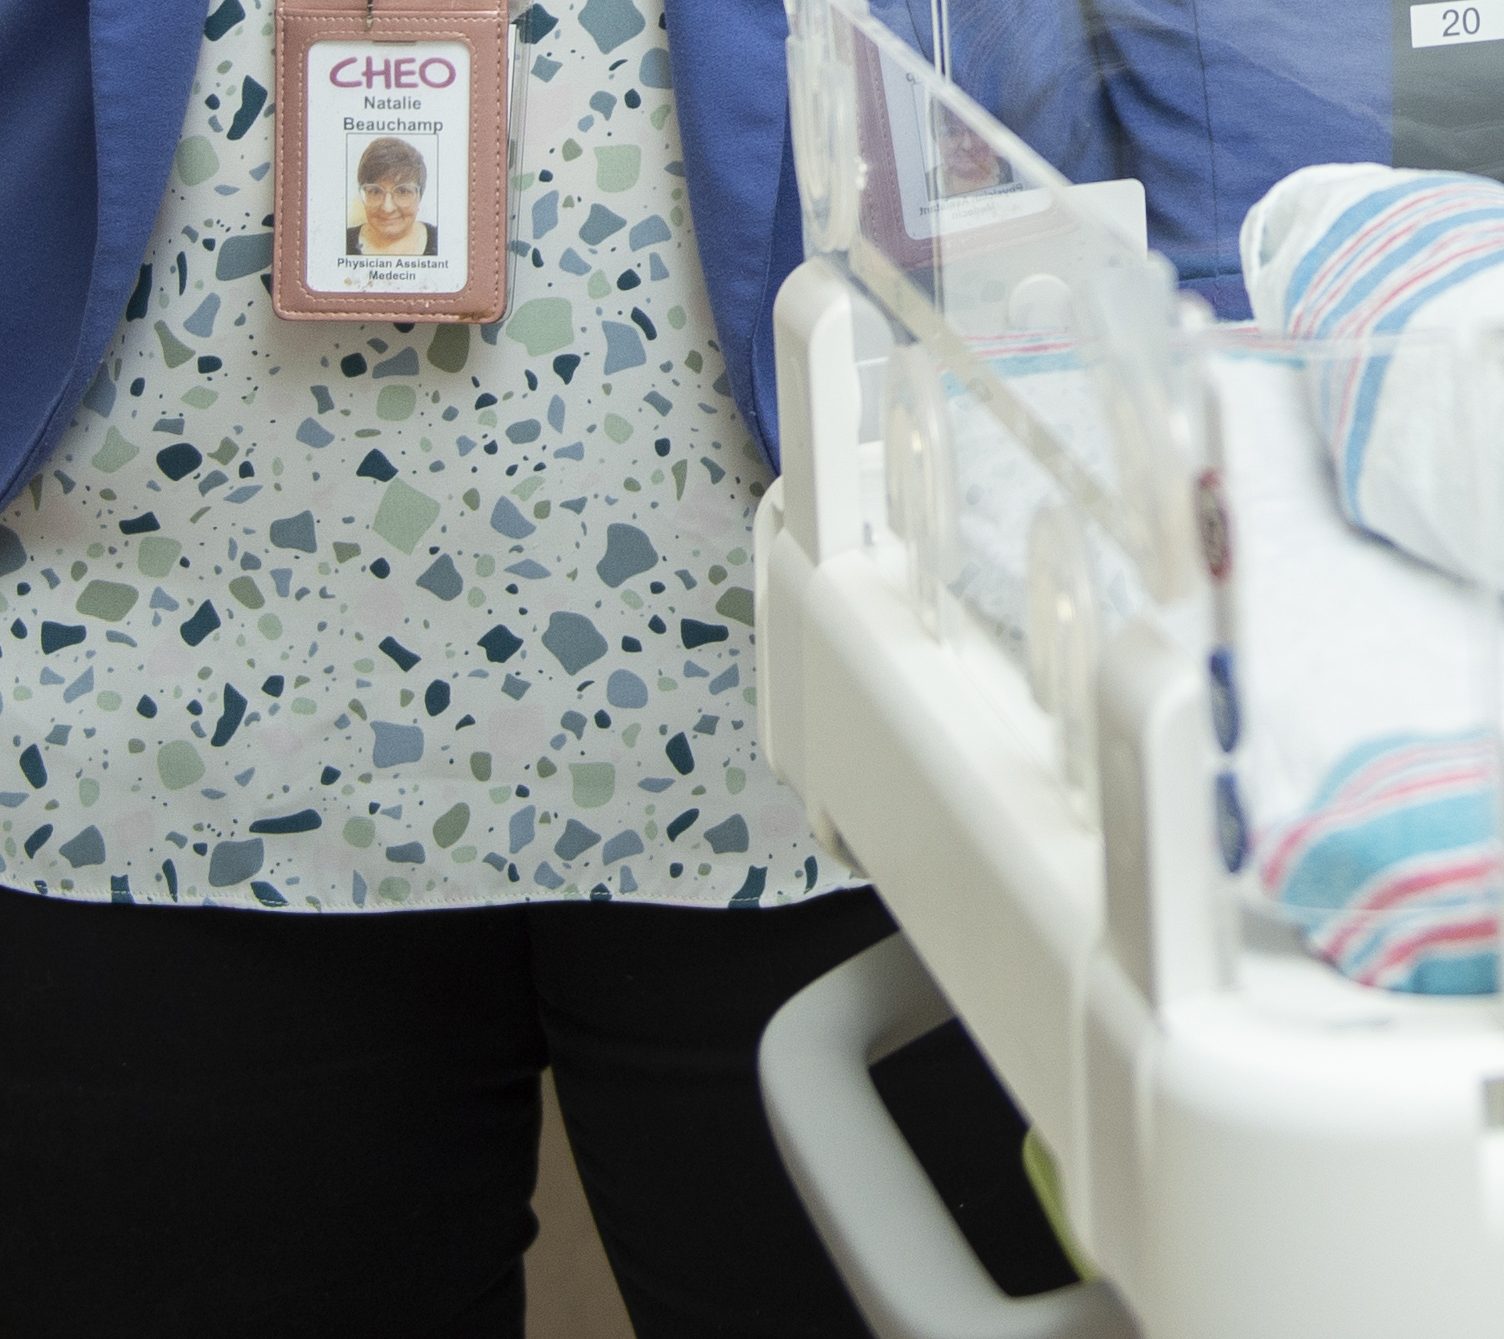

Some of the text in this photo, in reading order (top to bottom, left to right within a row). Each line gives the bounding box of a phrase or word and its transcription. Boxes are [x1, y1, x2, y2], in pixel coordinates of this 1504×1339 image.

[1441, 7, 1481, 38] 20
[329, 55, 457, 90] CHEO
[363, 95, 422, 111] Natalie
[342, 117, 444, 135] Beauchamp
[336, 257, 450, 271] Physician Assistant
[368, 270, 417, 281] Medecin
